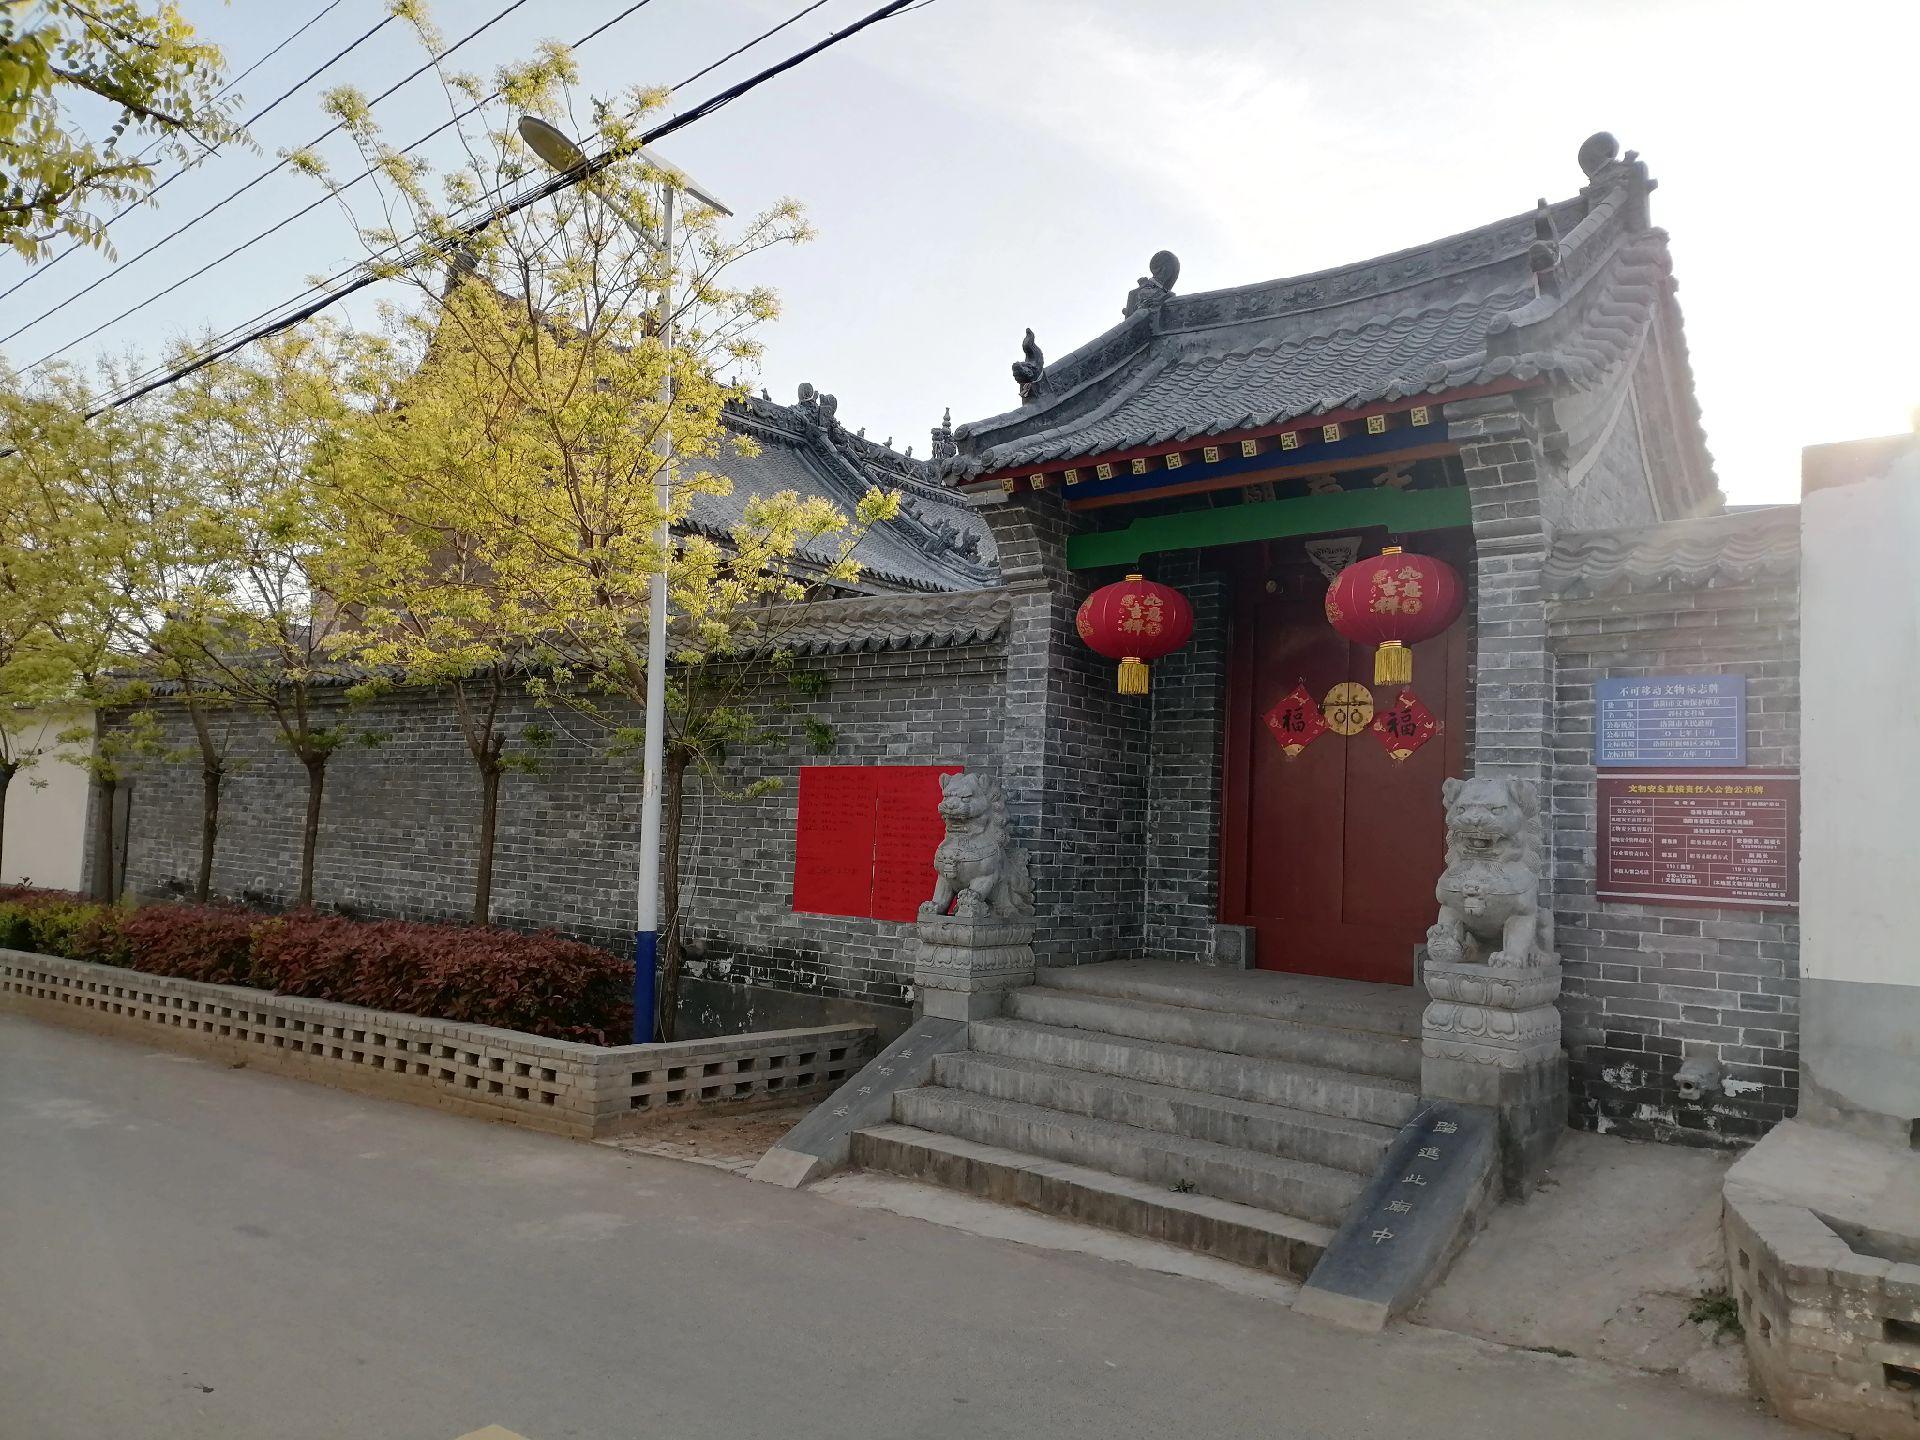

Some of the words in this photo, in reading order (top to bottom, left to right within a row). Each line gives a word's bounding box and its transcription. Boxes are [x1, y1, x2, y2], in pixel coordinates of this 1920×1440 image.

[1619, 683, 1720, 697] 不可移动文物标志牌
[1282, 707, 1306, 733] 福
[1386, 710, 1417, 737] 福
[1627, 784, 1765, 794] 文物安全直接责任人公告公示牌
